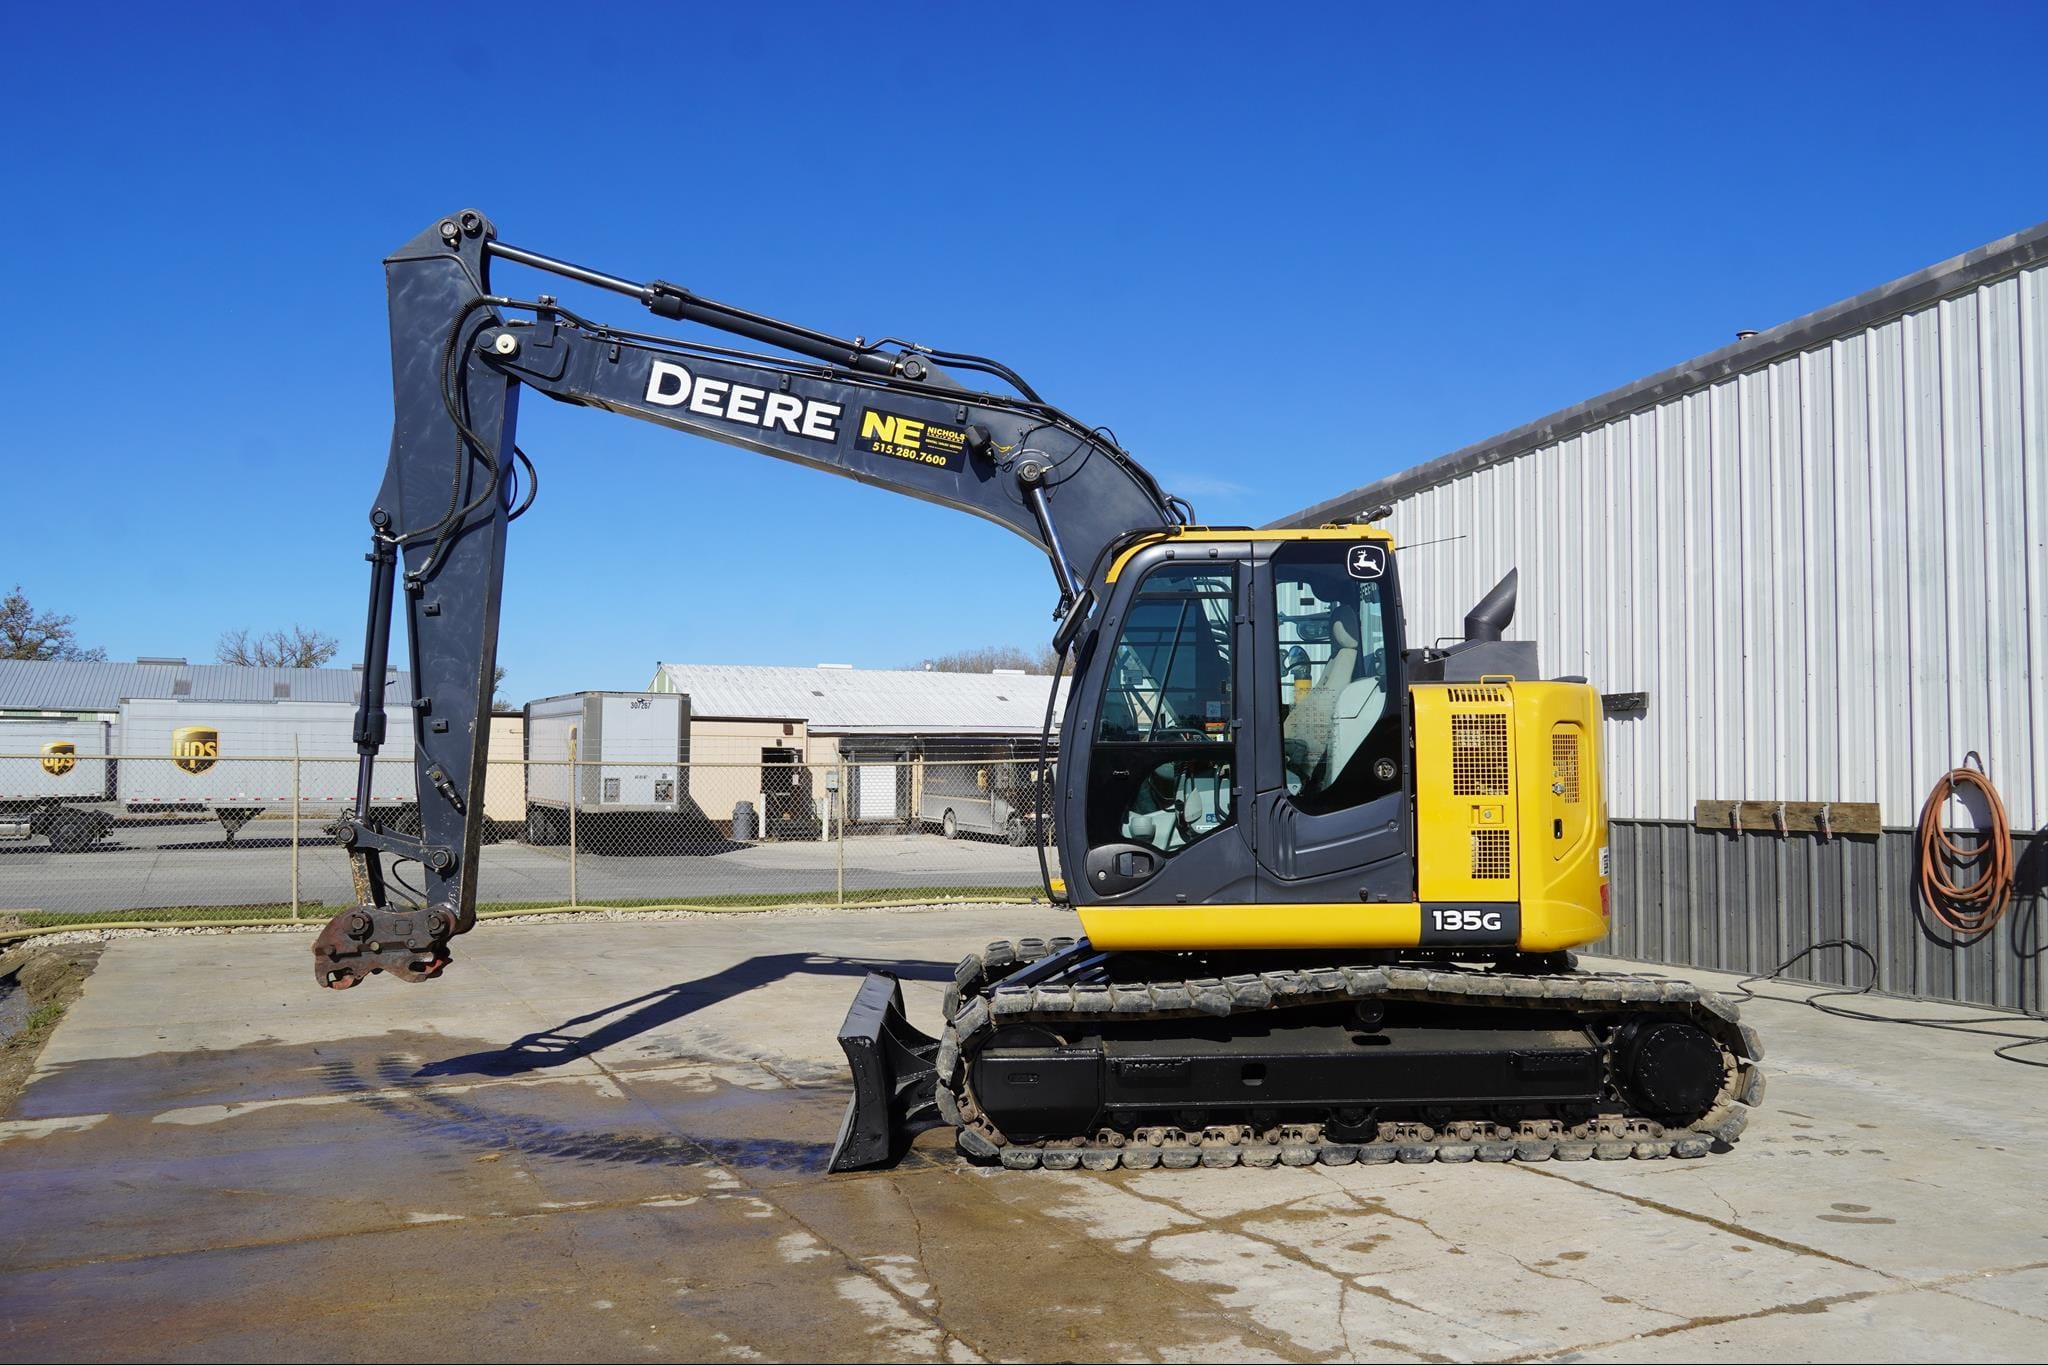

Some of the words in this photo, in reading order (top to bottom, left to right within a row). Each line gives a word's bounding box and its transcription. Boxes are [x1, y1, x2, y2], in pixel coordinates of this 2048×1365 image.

[645, 361, 841, 441] DEERE
[861, 410, 925, 449] NE
[927, 426, 966, 441] NICHOLS
[872, 442, 947, 466] 515.280.7600
[1432, 910, 1502, 931] 135G
